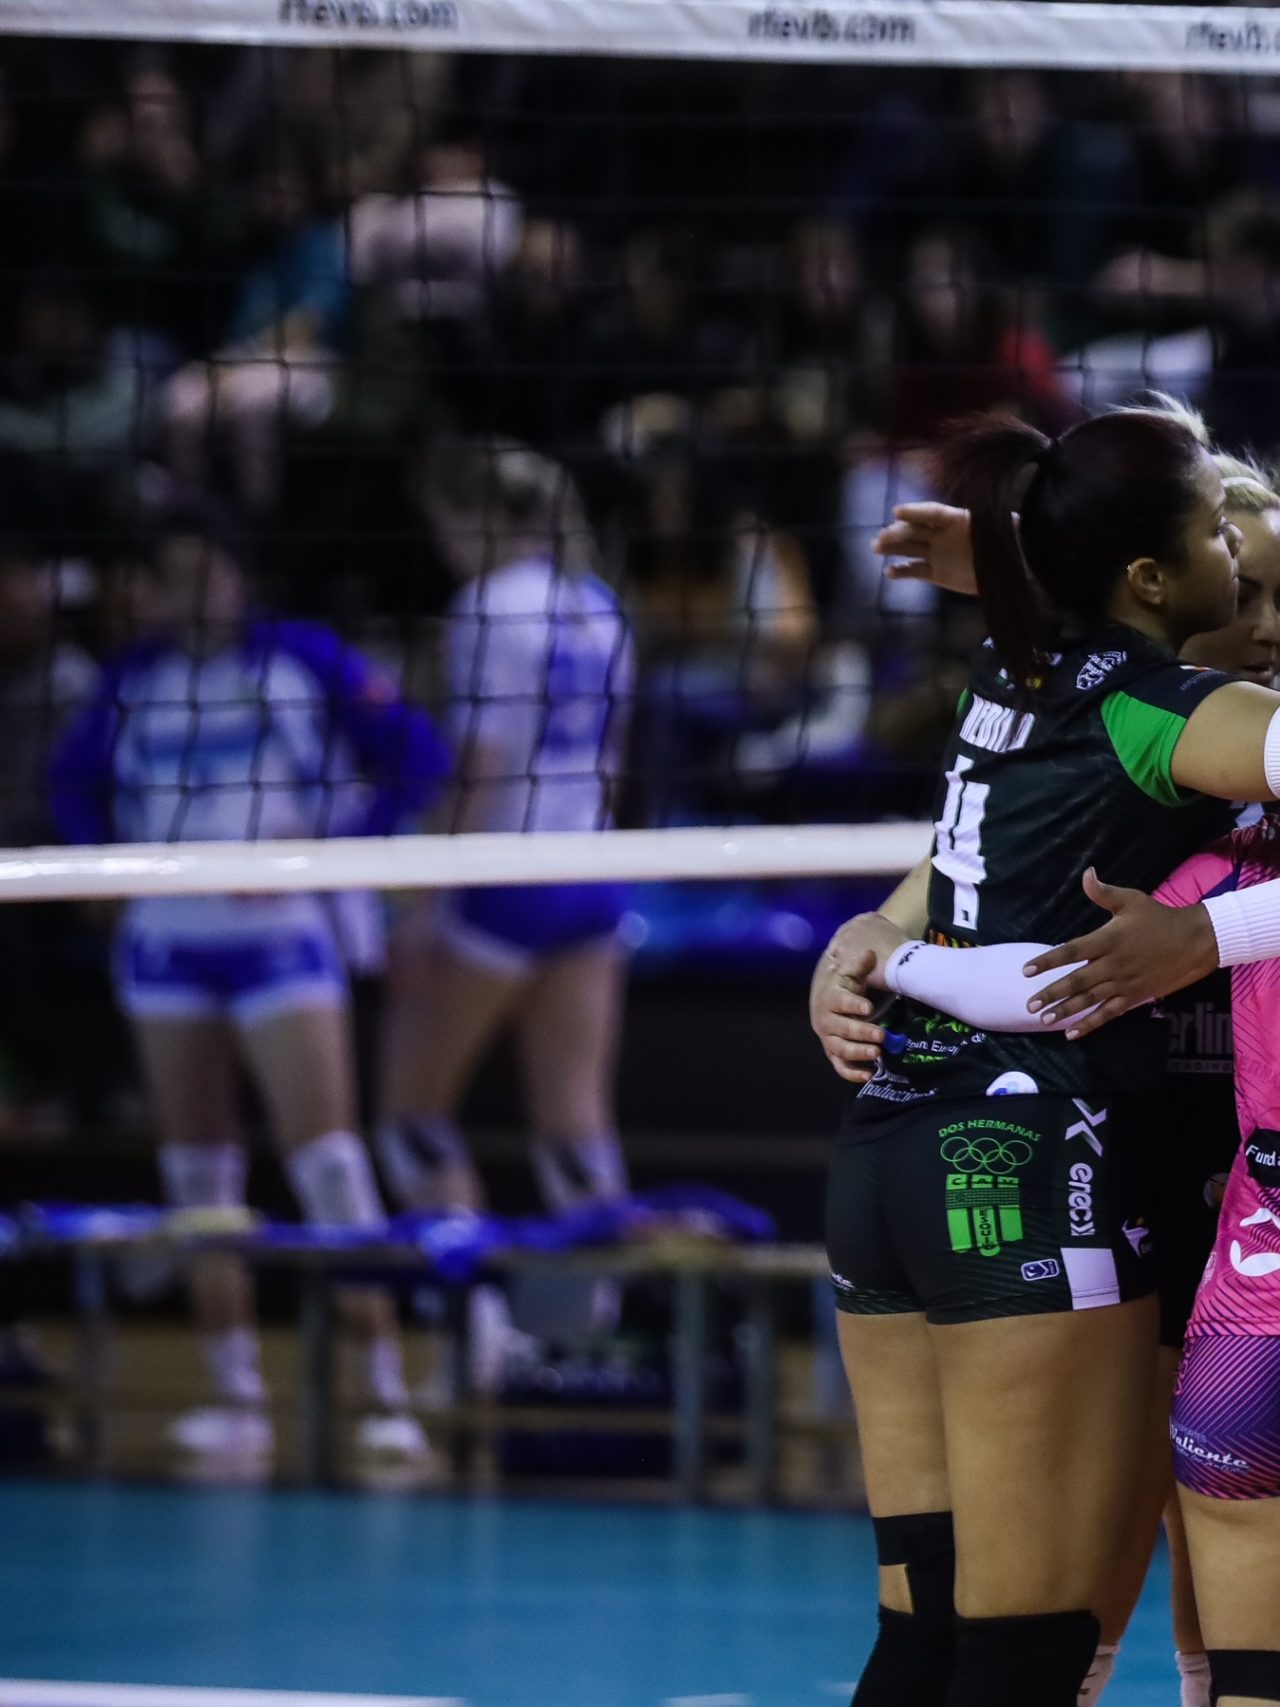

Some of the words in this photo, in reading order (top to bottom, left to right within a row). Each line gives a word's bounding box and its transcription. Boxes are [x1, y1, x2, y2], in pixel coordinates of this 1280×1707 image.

[931, 754, 991, 931] 4
[938, 1121, 966, 1138] DOS
[967, 1119, 1042, 1142] HERMANAS
